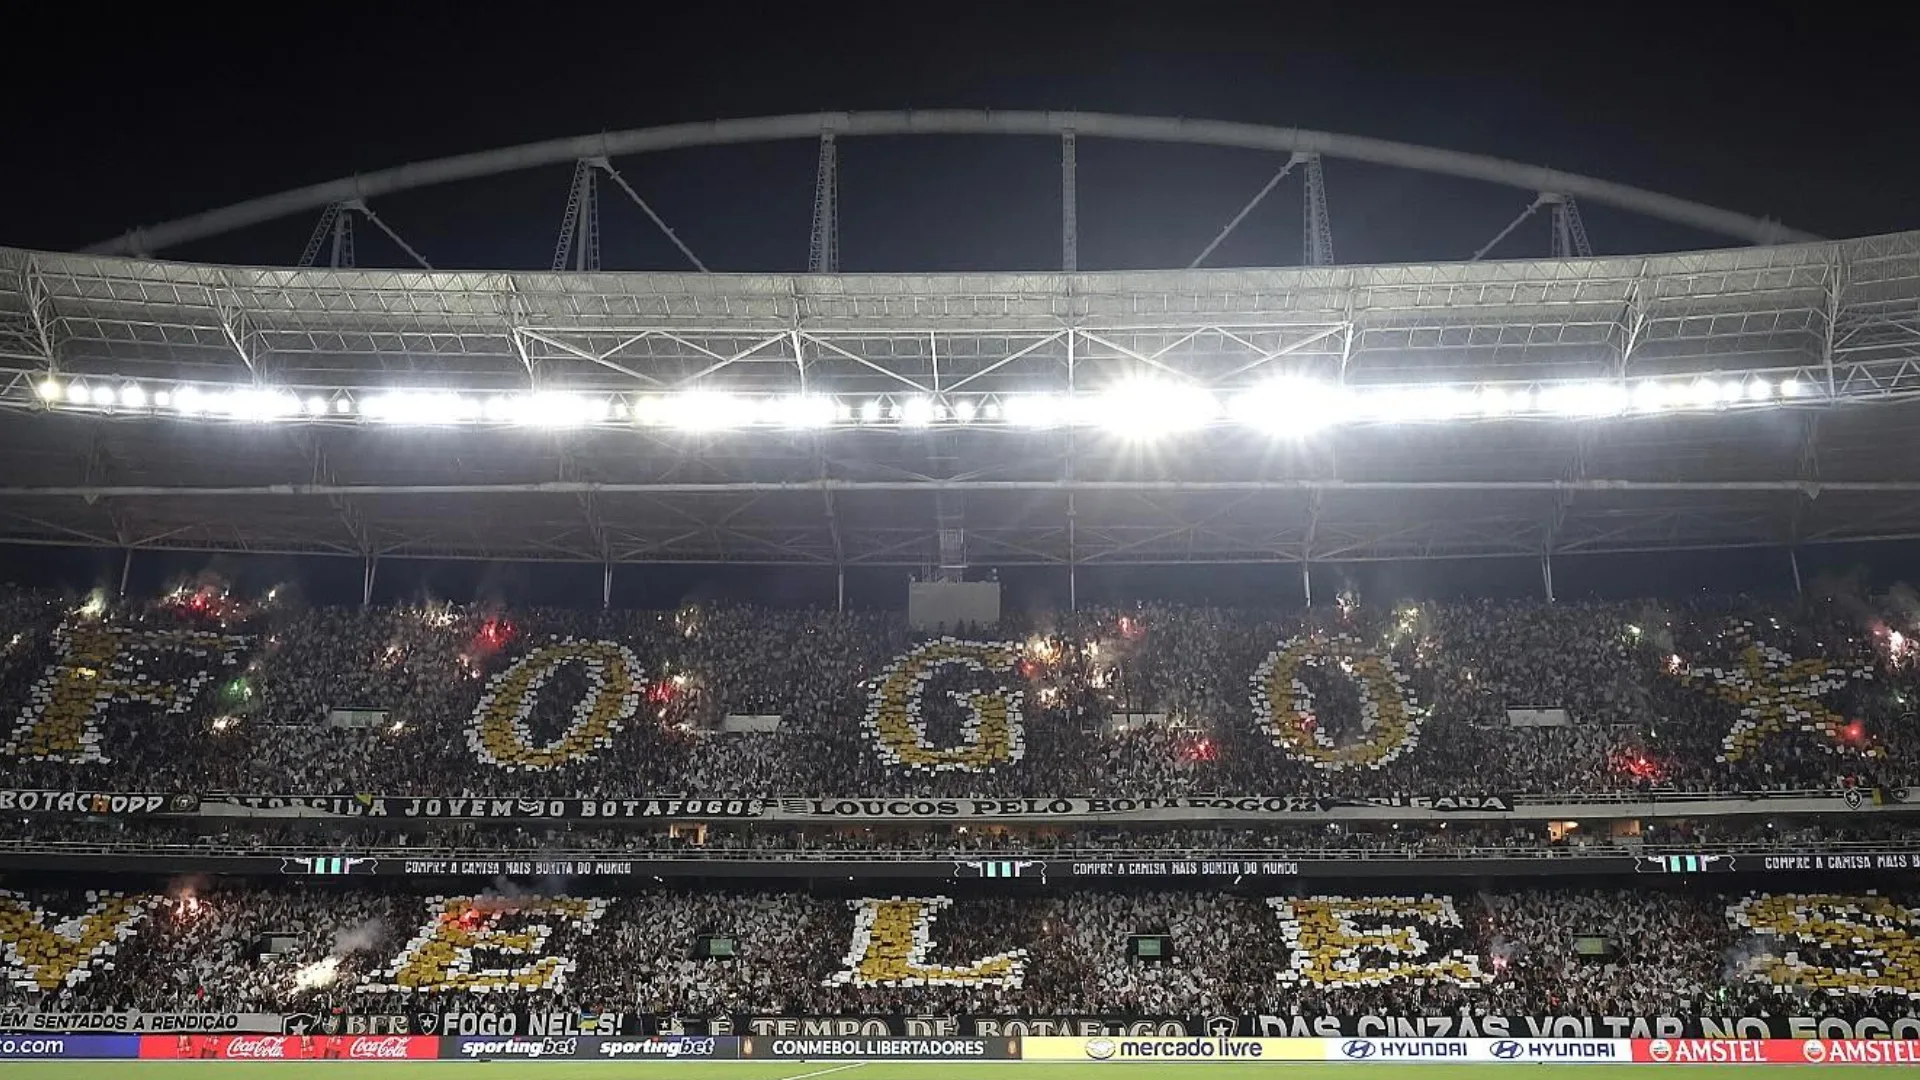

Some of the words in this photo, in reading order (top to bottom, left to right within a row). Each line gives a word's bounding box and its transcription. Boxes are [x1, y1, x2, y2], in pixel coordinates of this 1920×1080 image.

[405, 799, 514, 817] JOVEM
[580, 800, 743, 817] BOTAFOGO
[811, 800, 960, 815] LOUCOS
[971, 799, 1073, 815] PELO
[405, 861, 447, 874] COMPRE
[450, 861, 458, 874] A
[461, 861, 500, 875] CAMISA
[505, 861, 531, 875] MAIS
[535, 861, 573, 875] BONITA
[577, 861, 591, 875] DO
[595, 861, 632, 875] MUNDO
[1072, 862, 1114, 875] COMPRE
[1117, 862, 1126, 875] A
[1128, 862, 1167, 875] CAMISA
[1171, 862, 1198, 875] MAIS
[1201, 862, 1240, 875] BONITA
[1244, 862, 1257, 875] DO
[1262, 862, 1298, 875] MUNDO
[1764, 856, 1811, 870] COMPRE
[1815, 856, 1824, 869] A
[1828, 855, 1871, 869] CAMISA
[1877, 855, 1907, 868] MAIS
[33, 1014, 128, 1029] SENTADOS
[443, 1013, 518, 1035] FOGO
[528, 1013, 623, 1035] NELS!
[750, 1018, 890, 1036] TEMPO
[1259, 1015, 1342, 1037] DAS
[1700, 1016, 1771, 1039] NO
[0, 1038, 64, 1053] o.com
[462, 1037, 577, 1057] sportingbet
[600, 1037, 715, 1057] sportingbet
[772, 1040, 865, 1055] CONMEBOL
[866, 1040, 985, 1055] LIBERTADORES
[1120, 1038, 1214, 1056] mercado
[1218, 1038, 1262, 1057] livre
[1381, 1042, 1467, 1056] HYUNDAI
[1528, 1042, 1616, 1057] HYUNDAI
[1675, 1040, 1767, 1062] AMSTEL
[1829, 1040, 1920, 1062] AMSTEL
